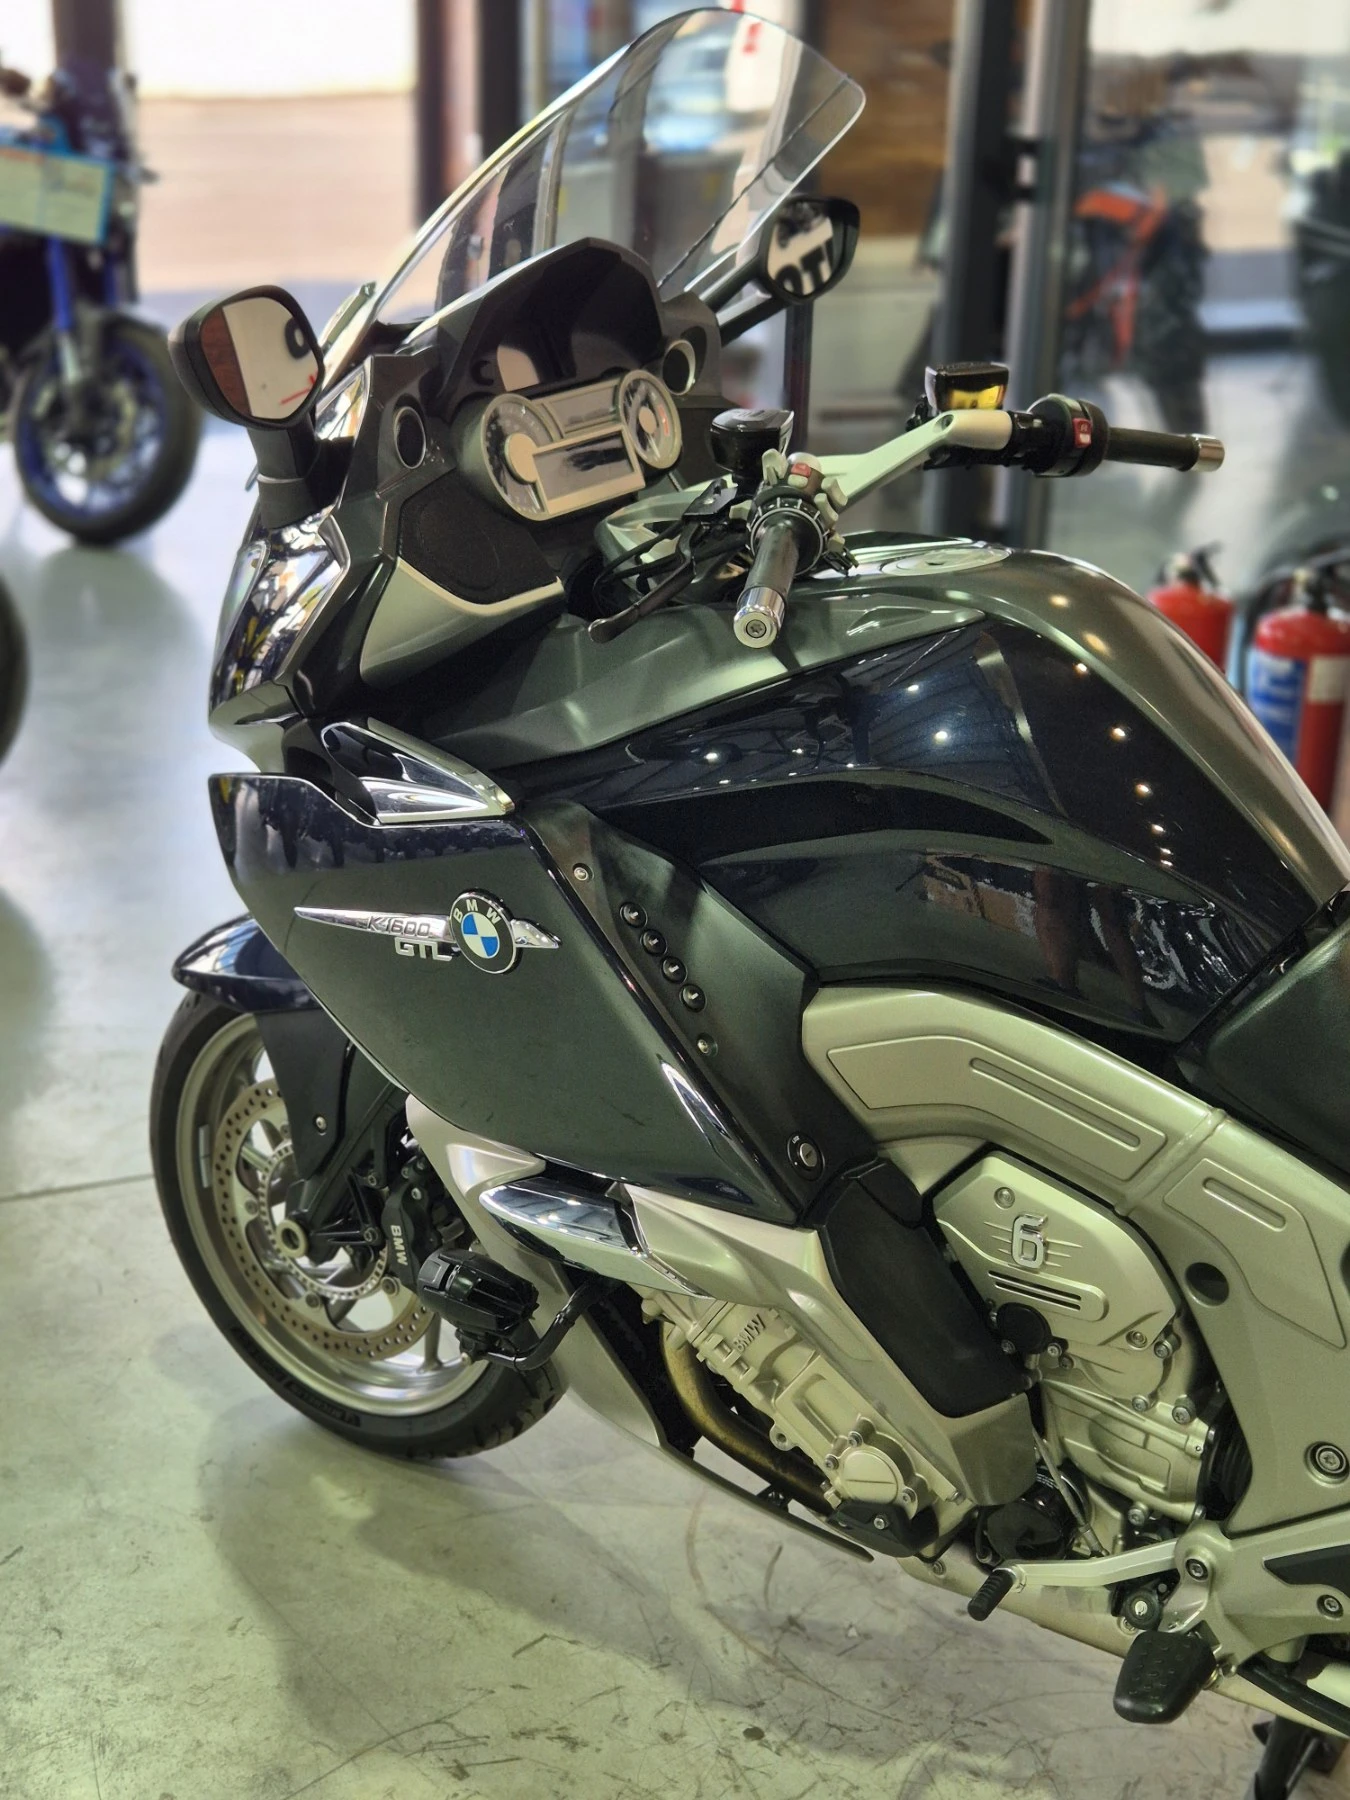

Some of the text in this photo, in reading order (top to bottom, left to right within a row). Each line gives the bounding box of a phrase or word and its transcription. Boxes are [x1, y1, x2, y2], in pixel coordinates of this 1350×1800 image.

[453, 898, 502, 924] BMW
[394, 936, 453, 962] GTL
[390, 1224, 409, 1266] BMW
[1012, 1213, 1048, 1270] 6
[733, 1313, 766, 1352] BMW
